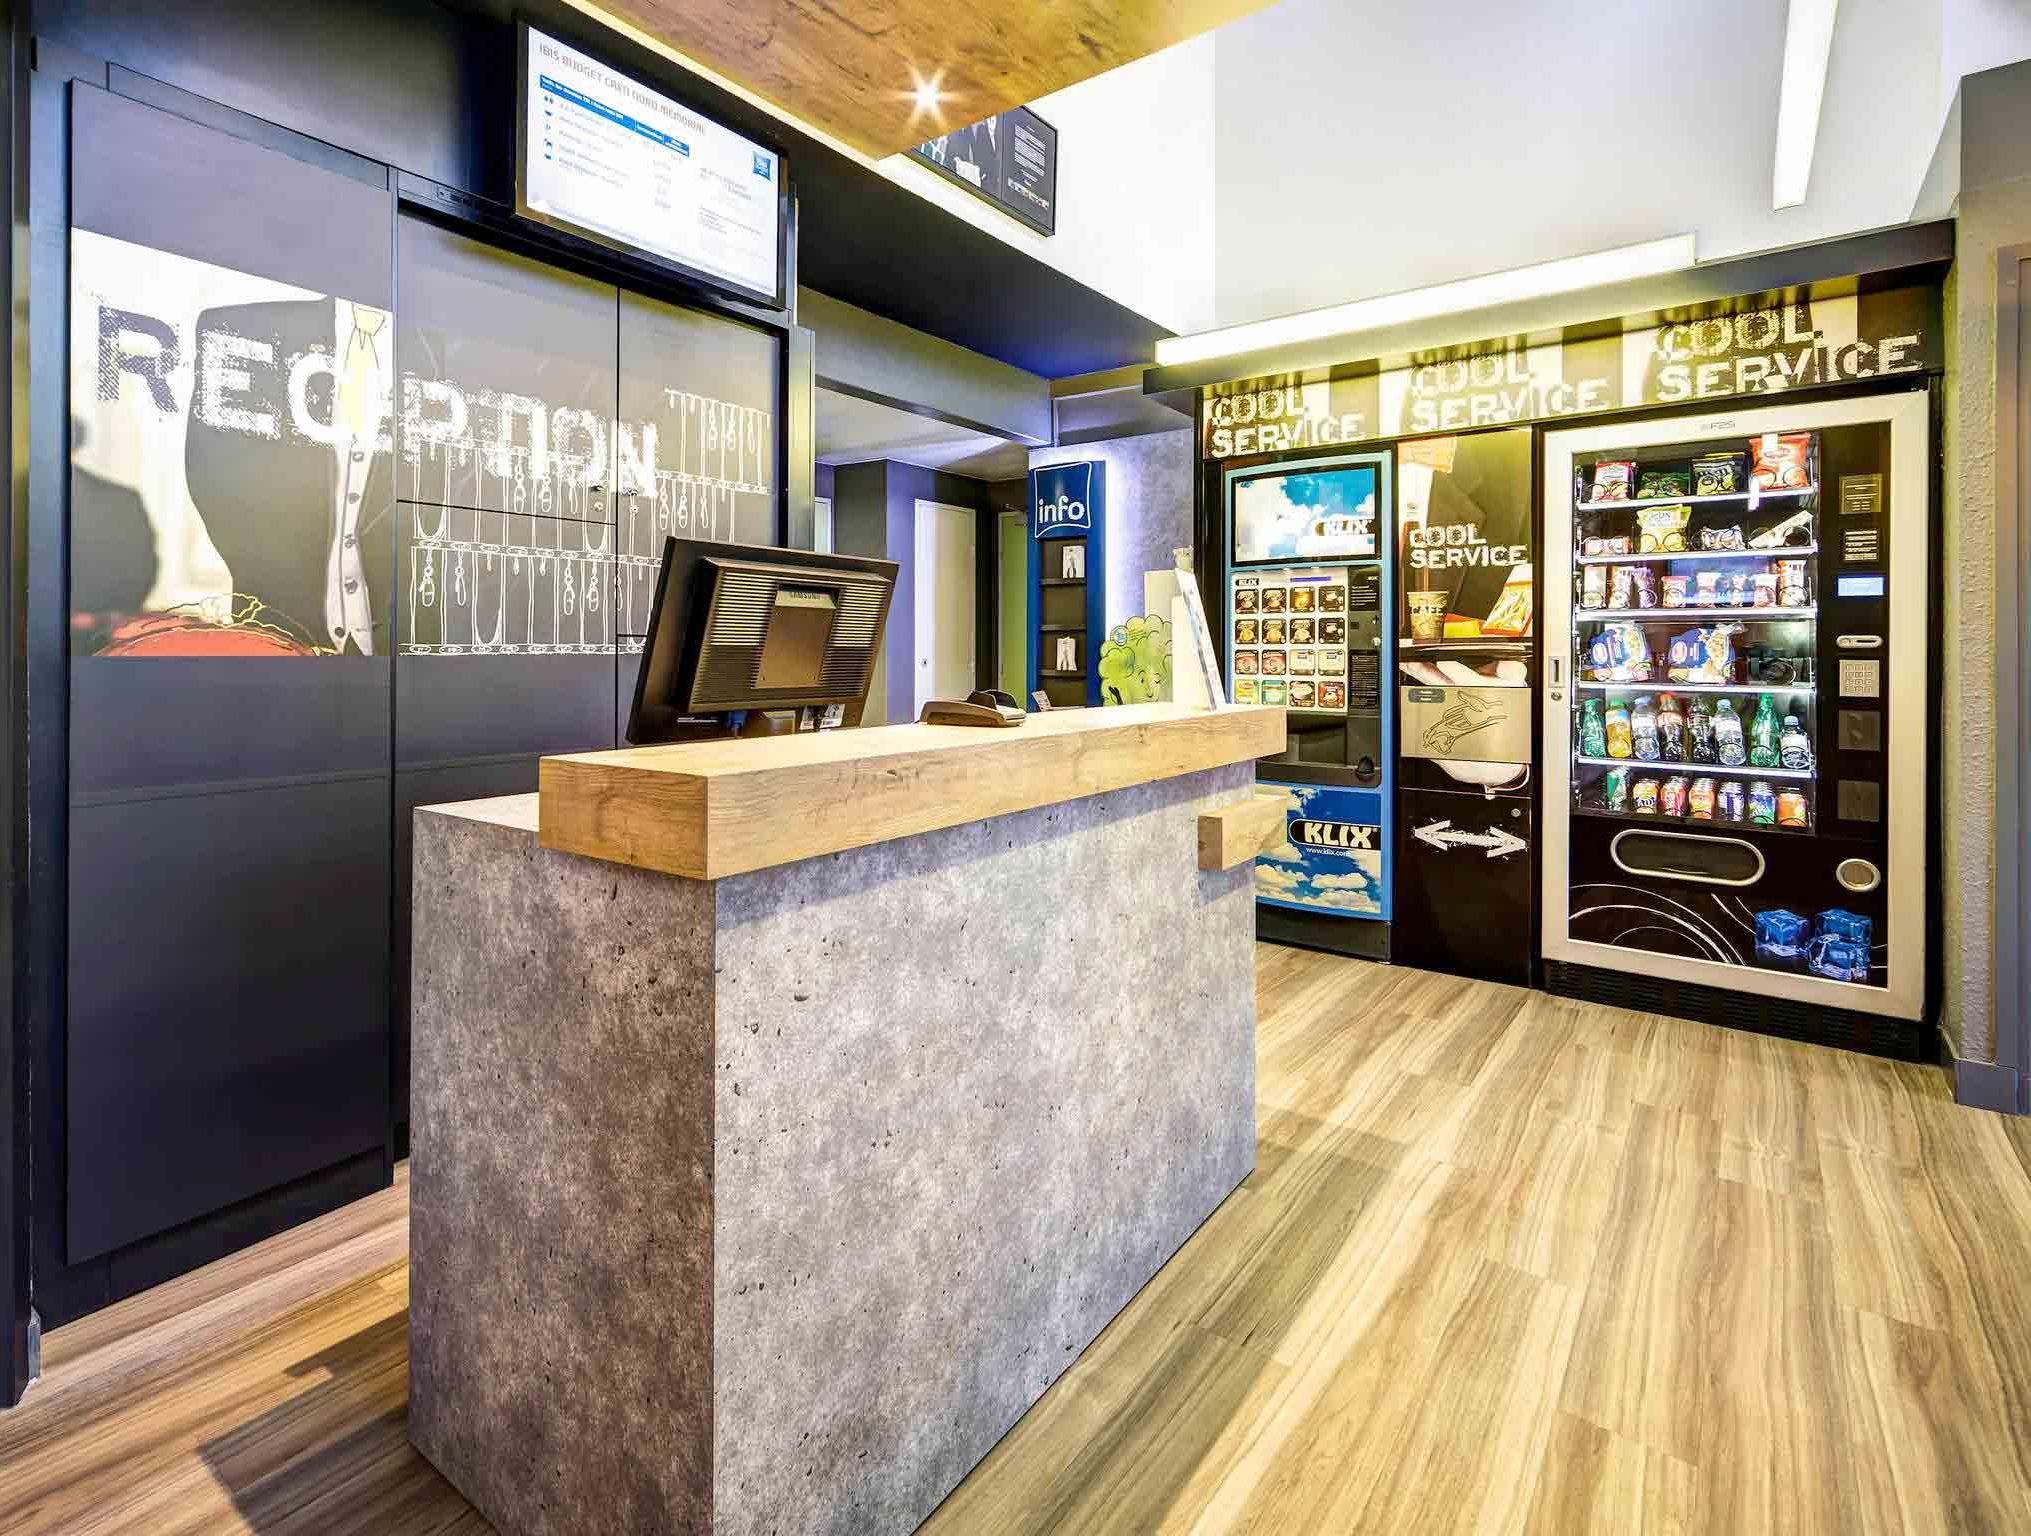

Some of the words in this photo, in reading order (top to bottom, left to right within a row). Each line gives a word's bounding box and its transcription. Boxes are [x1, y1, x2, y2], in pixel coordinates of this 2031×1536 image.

[1654, 305, 1824, 361] COOL
[1409, 350, 1534, 400] COOL
[1656, 330, 1927, 402] SERVICE
[97, 305, 658, 497] RECPTION
[1211, 385, 1309, 427] COOL
[1410, 376, 1611, 433] SERVICE
[1211, 411, 1367, 458] SERVICE
[1039, 496, 1085, 523] info
[1409, 522, 1487, 547] COOL
[1409, 544, 1529, 569] SERVICE
[1304, 822, 1373, 849] KLIX
[1306, 847, 1352, 858] www.klix.com
